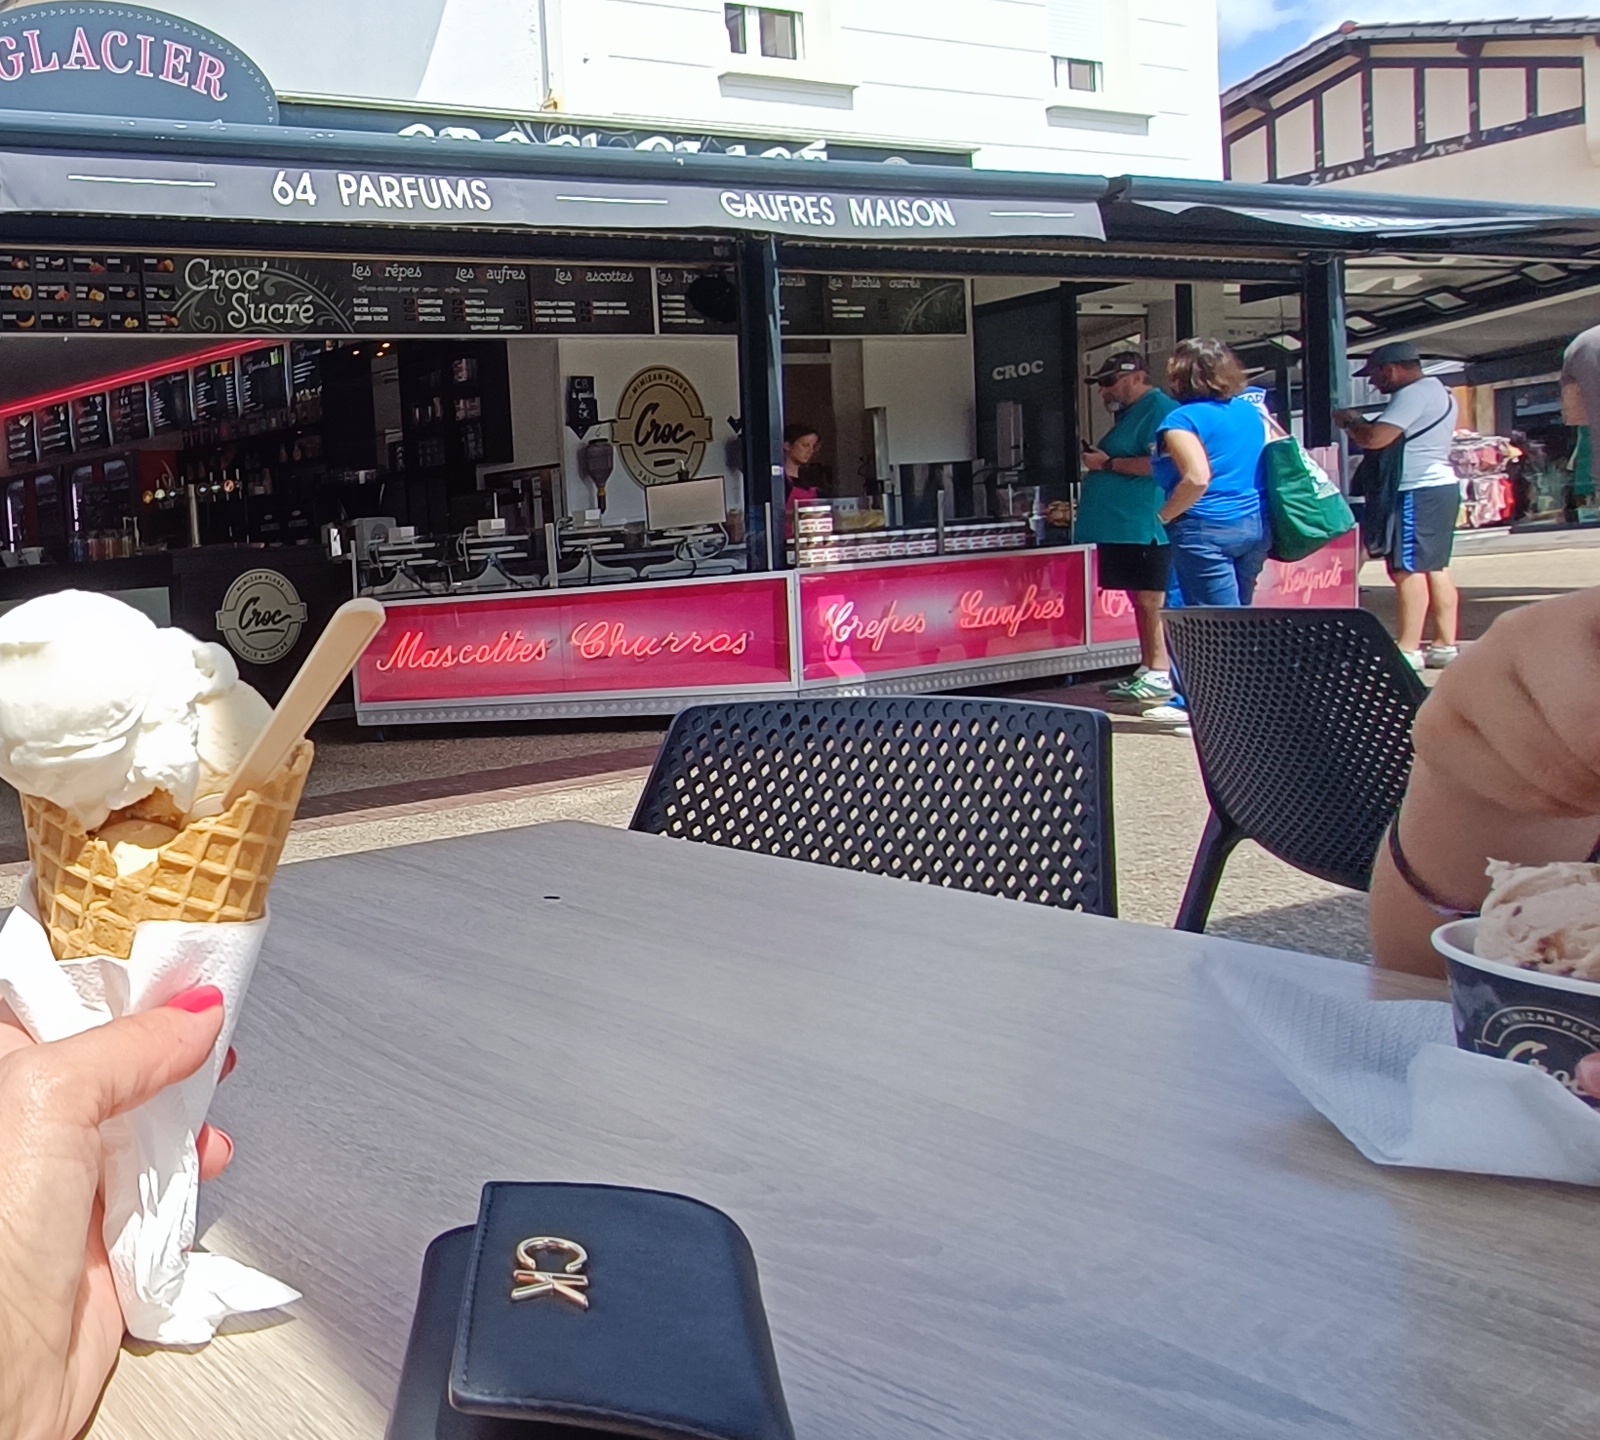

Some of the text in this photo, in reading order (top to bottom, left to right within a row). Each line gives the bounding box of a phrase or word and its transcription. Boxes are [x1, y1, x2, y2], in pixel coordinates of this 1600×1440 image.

[272, 170, 492, 211] 64 PARFUMS
[719, 191, 957, 227] GAUFRES MAISON
[184, 257, 269, 292] Croc'
[352, 262, 371, 281] Les
[455, 266, 475, 283] Les
[554, 267, 572, 286] Les
[227, 293, 315, 329] Sucré
[991, 359, 1044, 381] CROC
[634, 402, 696, 447] Croc
[238, 595, 293, 630] Croc
[959, 583, 1066, 638] Gaufres
[375, 620, 751, 672] Mascottes Churros
[510, 1235, 590, 1311] CK
